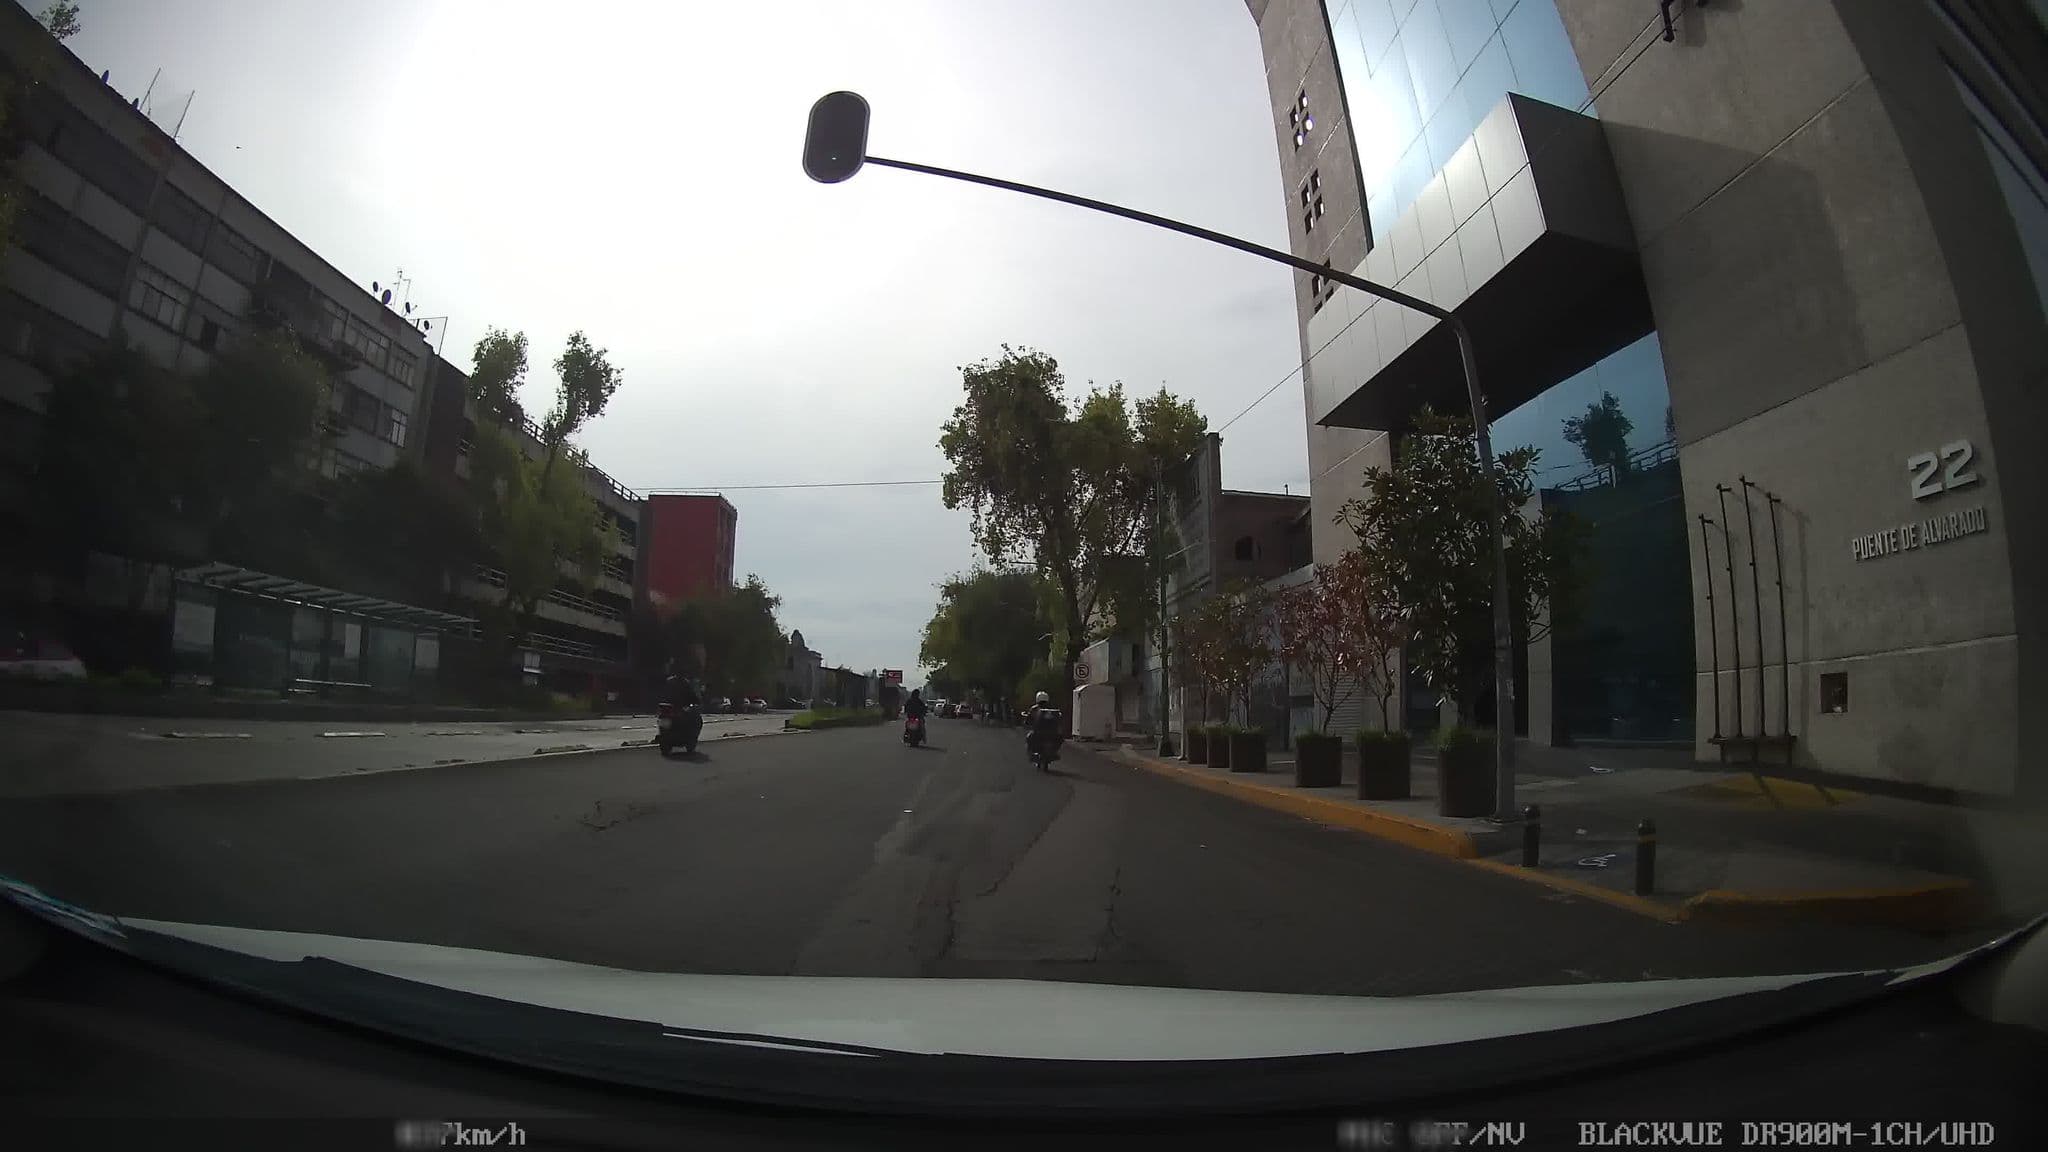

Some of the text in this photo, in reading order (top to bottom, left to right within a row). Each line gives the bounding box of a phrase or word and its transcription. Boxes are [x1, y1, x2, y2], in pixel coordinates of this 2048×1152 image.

[1908, 440, 1978, 499] 22
[1852, 506, 1986, 560] PUENTE DE ALVARADO
